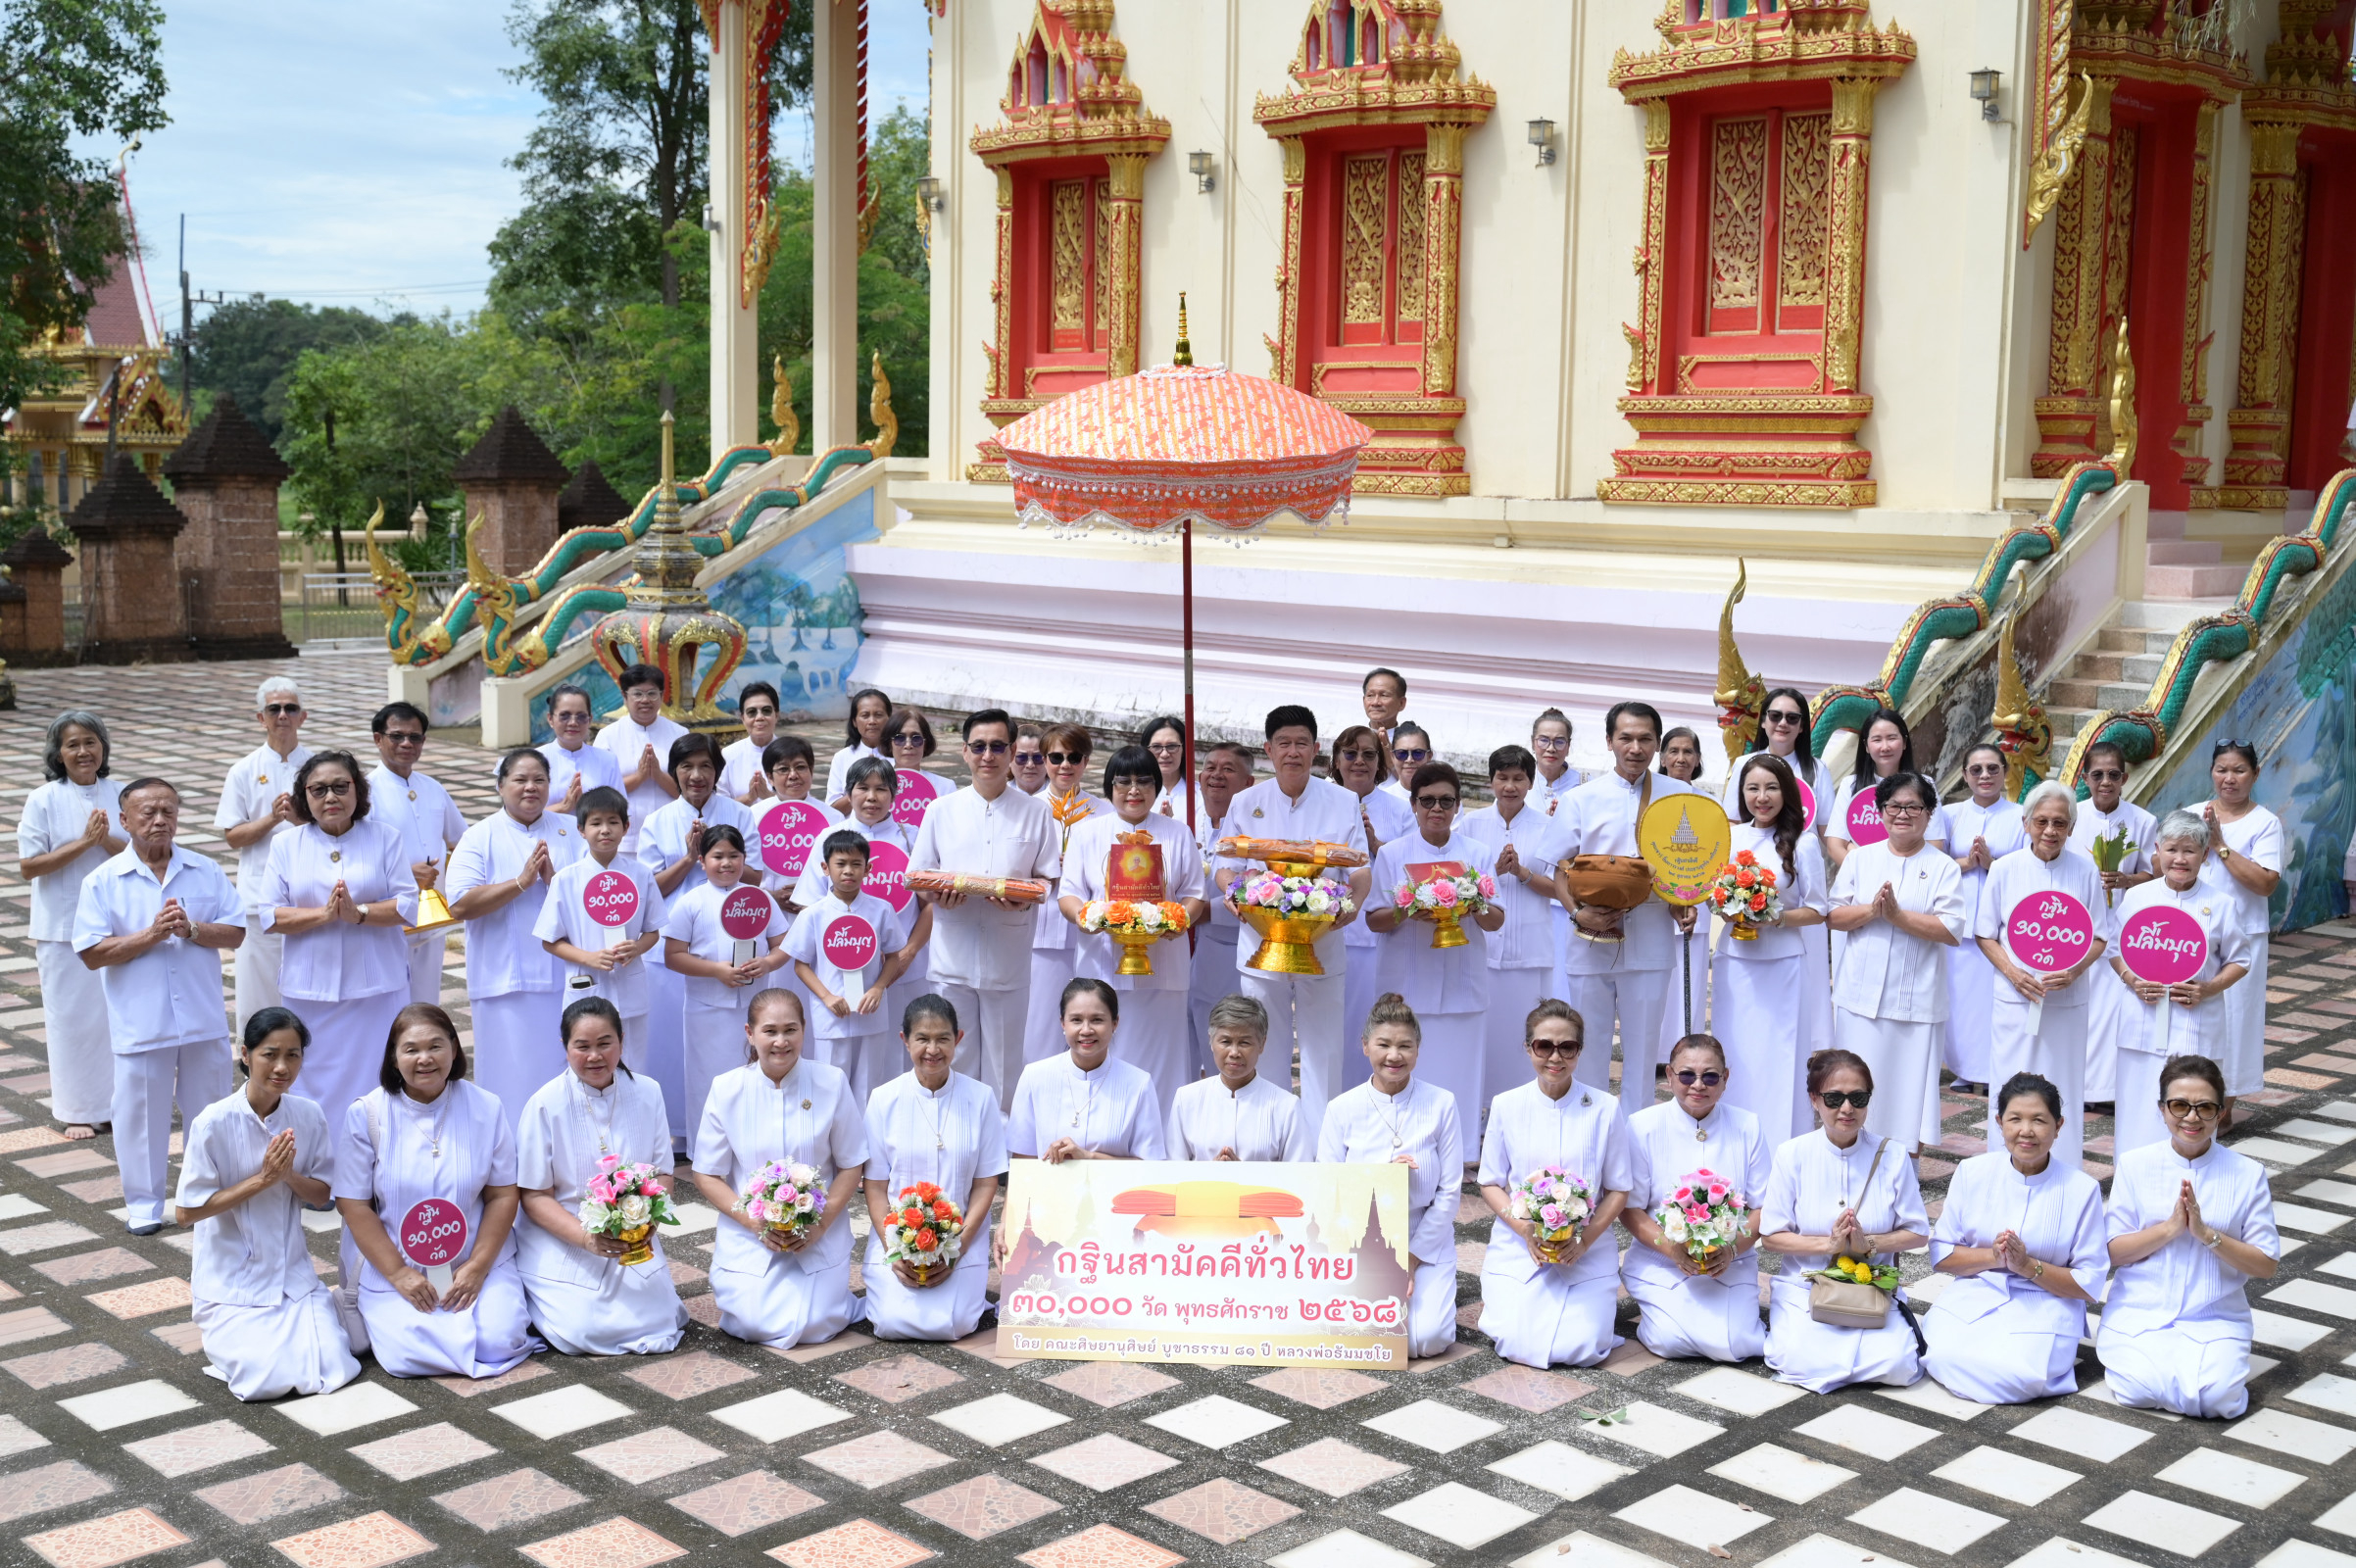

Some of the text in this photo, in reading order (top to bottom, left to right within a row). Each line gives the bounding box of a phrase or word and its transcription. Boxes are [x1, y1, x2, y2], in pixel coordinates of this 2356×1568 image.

[897, 774, 913, 795] ฐิน
[781, 806, 807, 829] กฐิน
[762, 833, 815, 850] 30,00
[783, 855, 803, 870] วัด
[599, 874, 617, 892] กฐิน
[589, 892, 634, 907] 30,000
[725, 897, 768, 924] ปลื้มบุญ
[2039, 896, 2069, 919] กฐิน
[605, 909, 620, 921] วัด
[827, 925, 872, 954] ปลื้มบุญ
[2014, 920, 2086, 945] 30,000
[2127, 921, 2201, 963] ปลื้มบุญ
[2033, 948, 2054, 965] วัด
[418, 1204, 440, 1225] กฐิน
[408, 1220, 461, 1247] 30,000
[429, 1244, 447, 1259] วัด
[1057, 1235, 1353, 1285] กฐินสามัคคีทั่วไทย
[1012, 1294, 1397, 1325] ๓๐,๐๐๐ วัด พุทธศักราช ๒๕๖๘
[1014, 1335, 1391, 1360] โดย คณะศิษยานุศิษย์ บูชาธรรม ๘๑ ปี หลวงพ่อธัมมชโย
